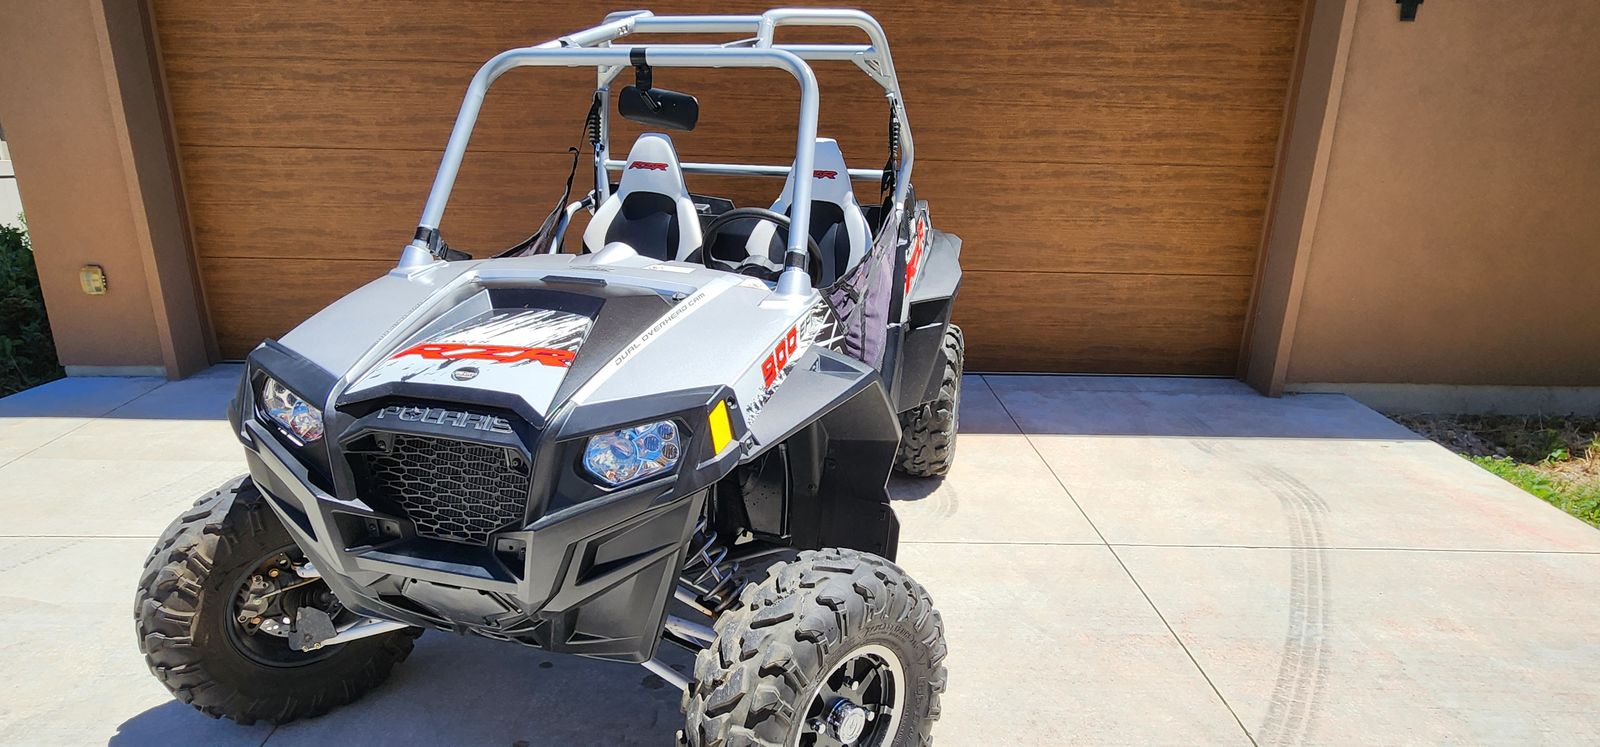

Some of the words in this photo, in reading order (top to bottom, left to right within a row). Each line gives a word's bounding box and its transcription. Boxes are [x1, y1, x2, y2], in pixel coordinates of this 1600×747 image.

[812, 169, 838, 180] ZR
[614, 342, 641, 366] DUAL
[641, 304, 688, 341] OVERHEAD
[688, 292, 706, 307] CAM
[389, 343, 576, 368] RZR
[761, 324, 798, 389] 900
[377, 405, 514, 434] POLARIS
